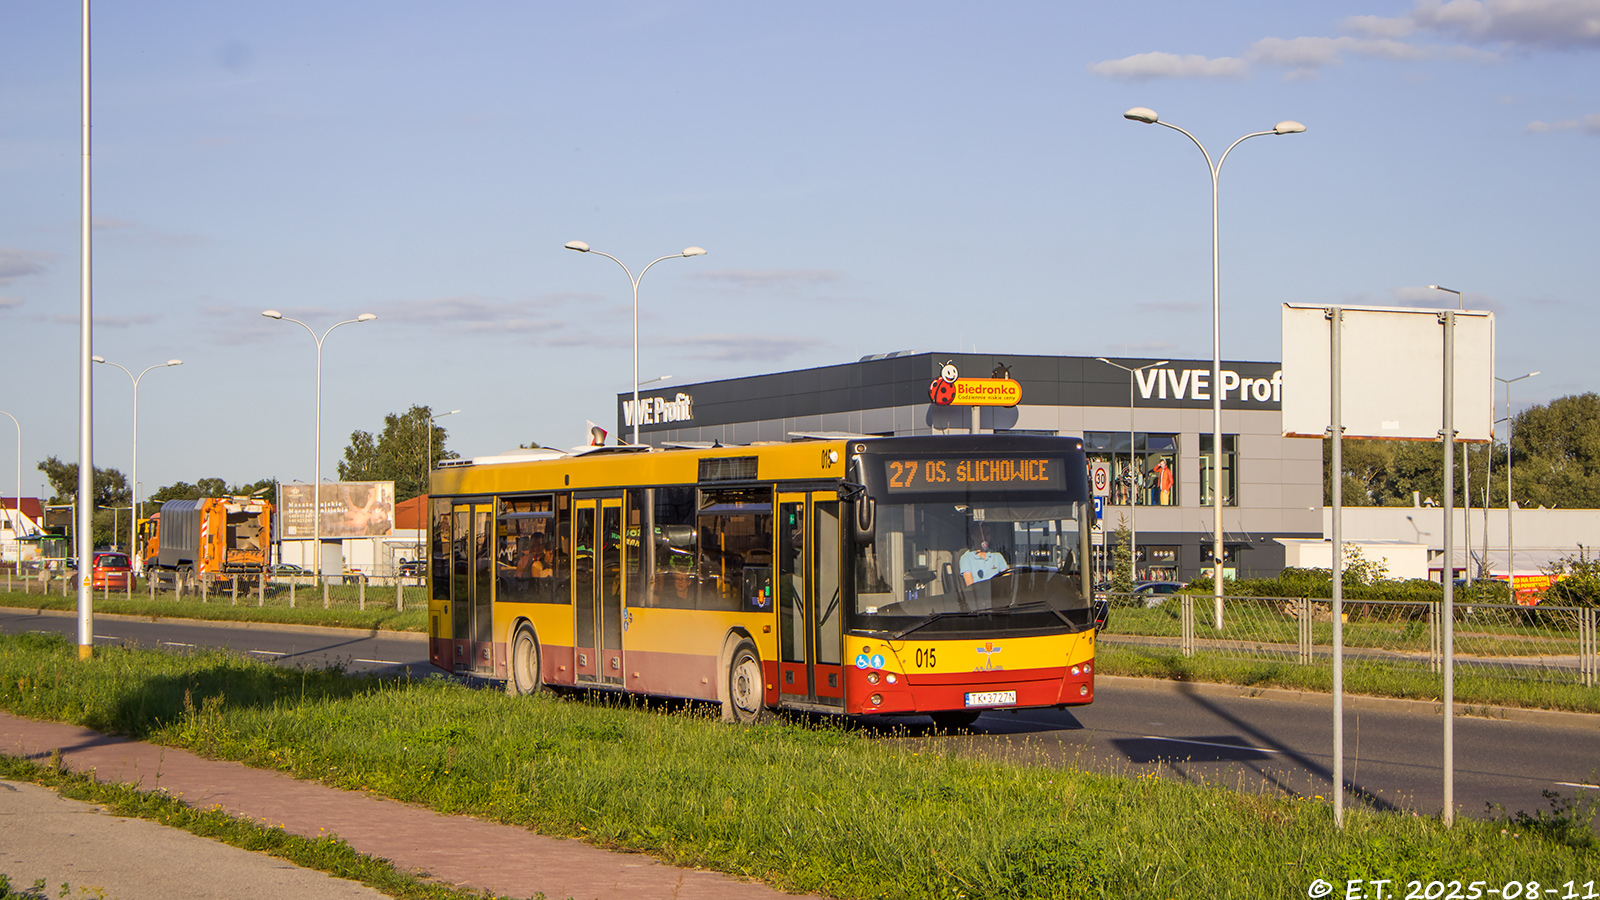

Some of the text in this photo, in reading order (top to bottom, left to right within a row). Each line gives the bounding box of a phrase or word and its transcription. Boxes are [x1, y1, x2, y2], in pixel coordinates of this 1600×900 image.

[957, 383, 1016, 395] Biedronka
[1134, 368, 1211, 401] VIVE
[653, 392, 692, 425] Profit
[890, 460, 918, 488] 27
[925, 460, 951, 483] OS.
[1096, 473, 1105, 485] 30
[319, 501, 343, 509] ajskie
[915, 647, 937, 668] 015
[971, 693, 984, 704] TK
[987, 692, 1015, 704] 3727N
